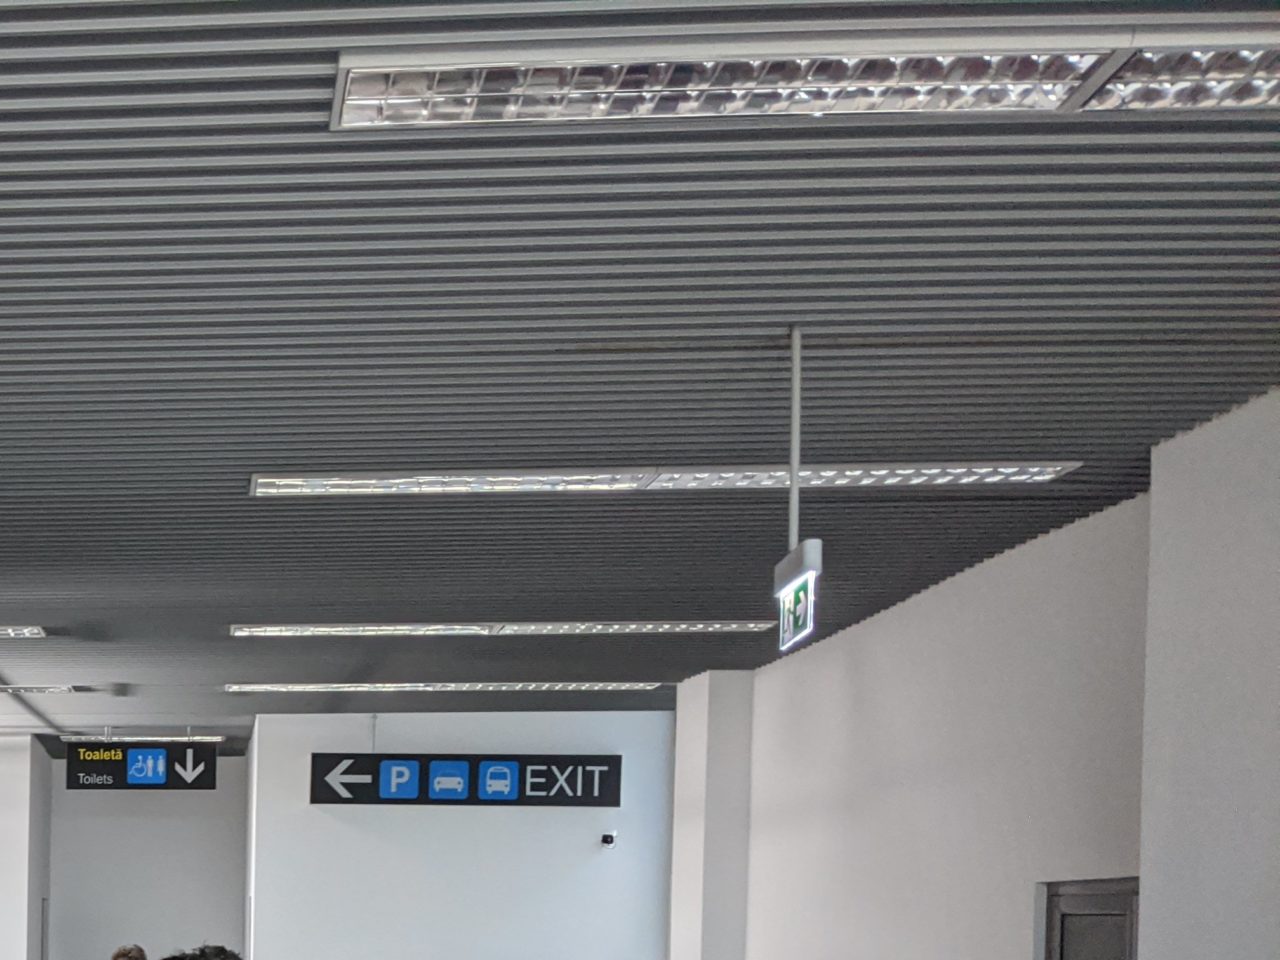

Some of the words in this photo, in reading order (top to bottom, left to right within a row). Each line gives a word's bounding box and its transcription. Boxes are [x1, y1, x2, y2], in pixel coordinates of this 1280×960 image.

[77, 772, 114, 785] Toilets
[390, 766, 411, 793] P
[525, 765, 609, 797] EXIT
